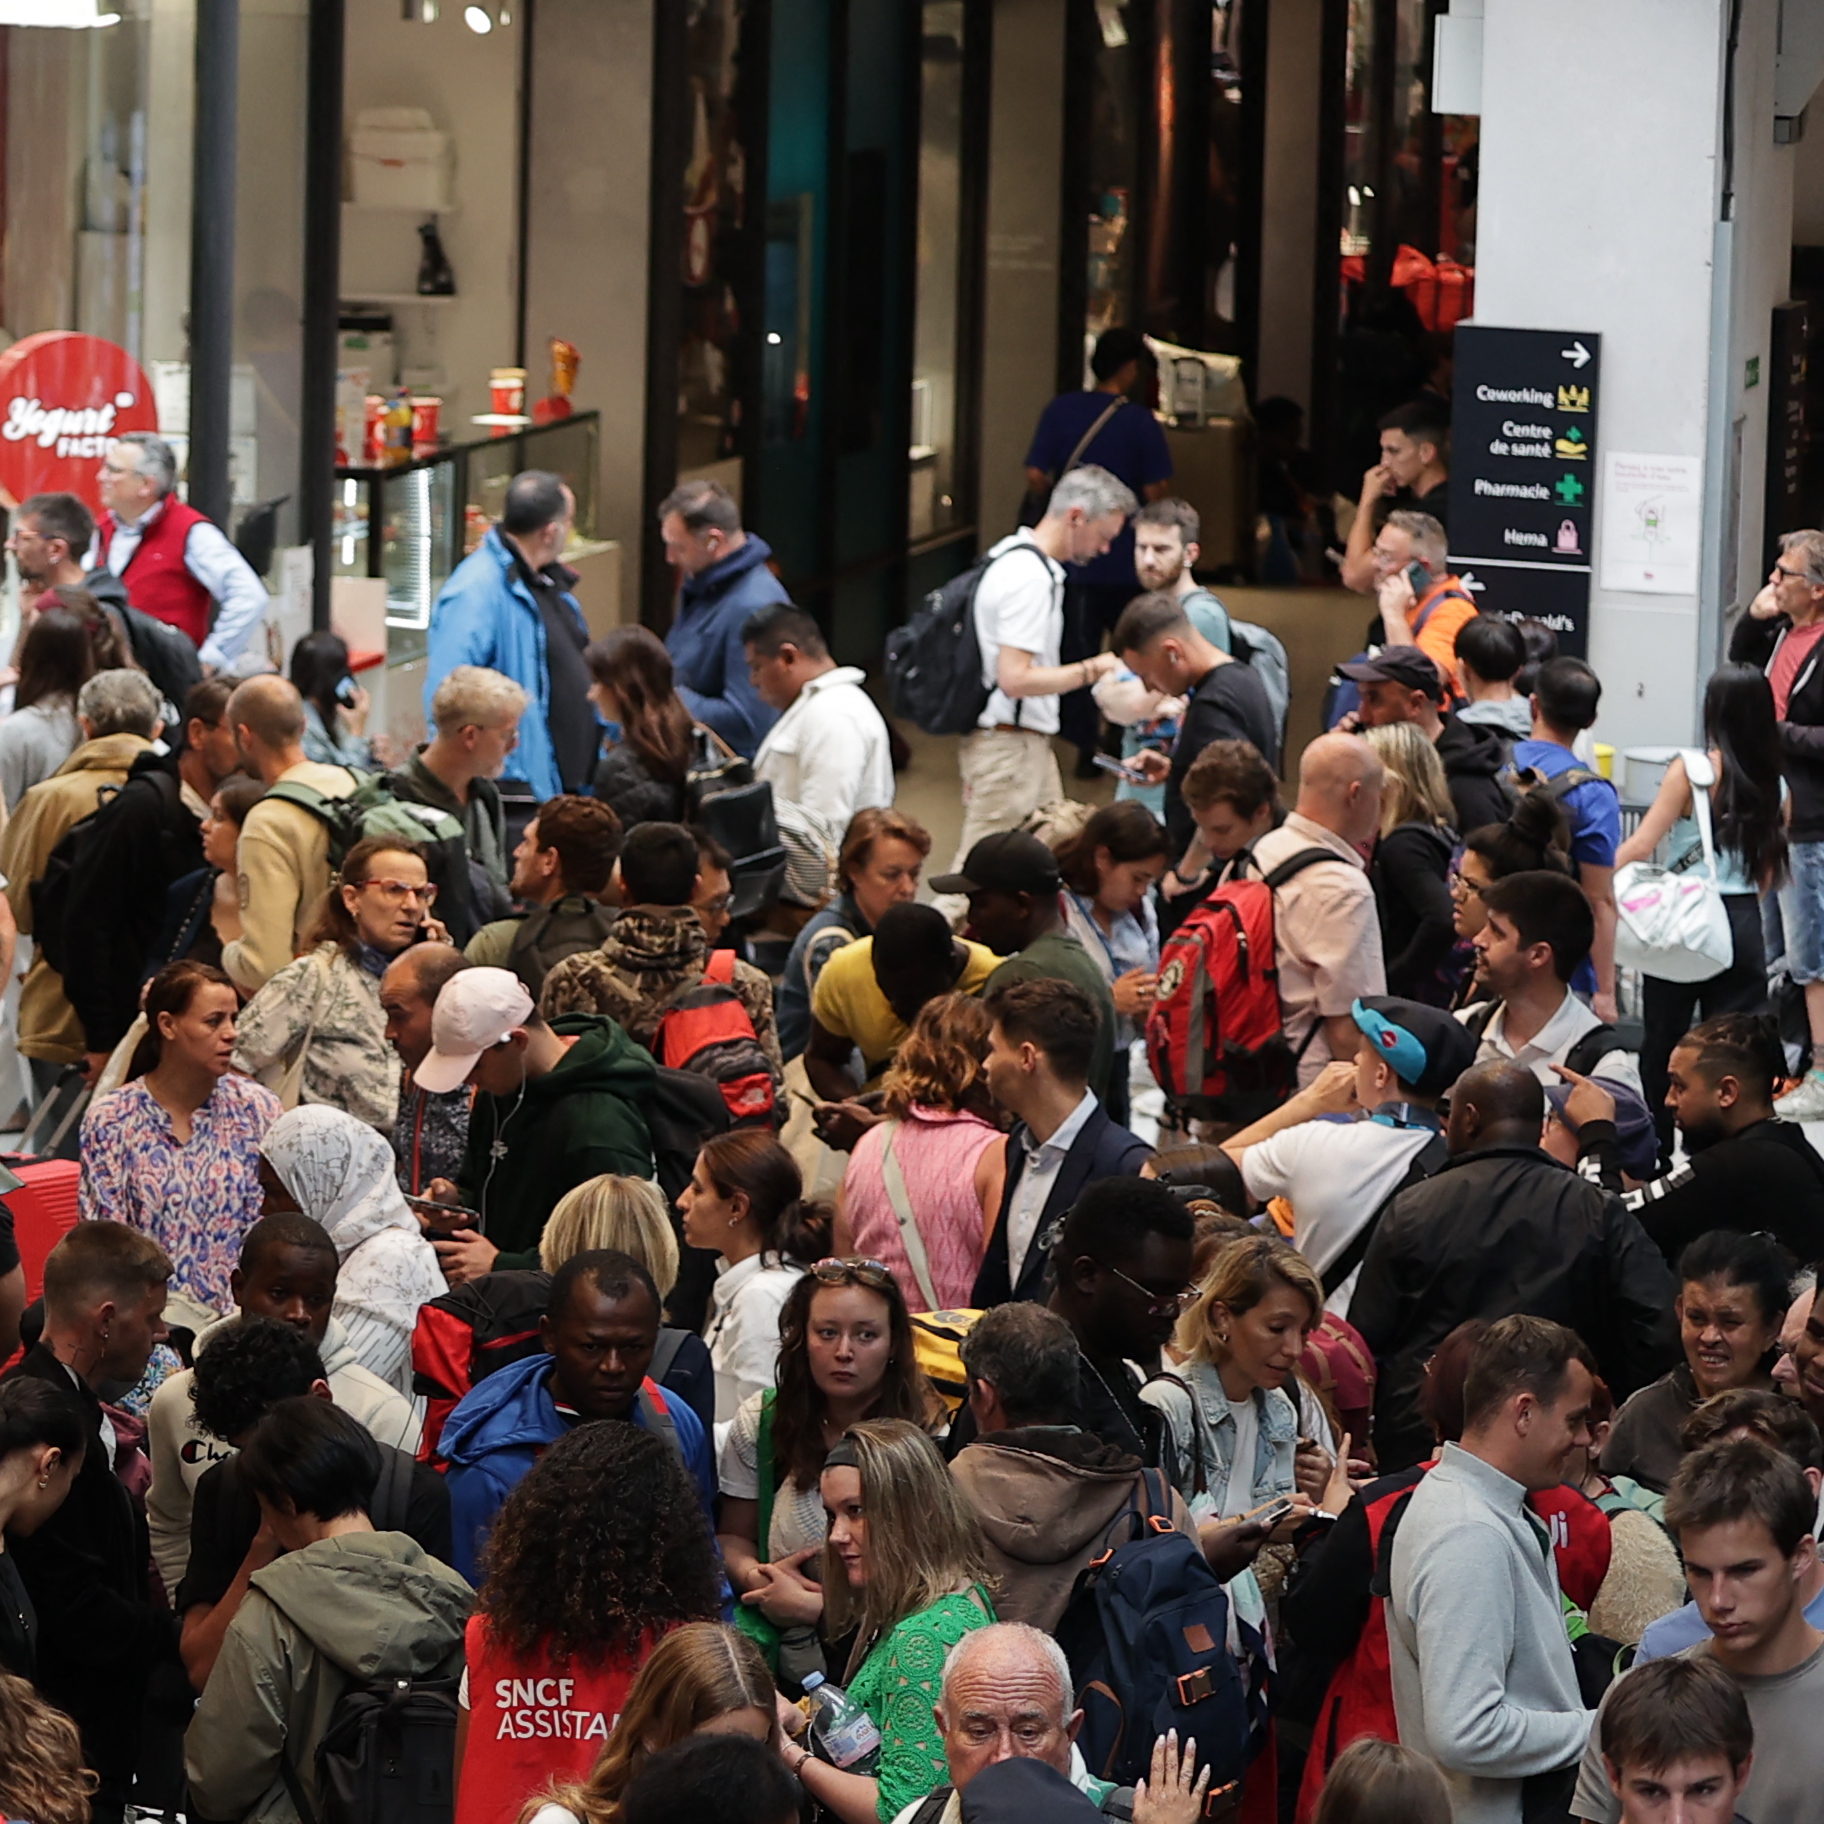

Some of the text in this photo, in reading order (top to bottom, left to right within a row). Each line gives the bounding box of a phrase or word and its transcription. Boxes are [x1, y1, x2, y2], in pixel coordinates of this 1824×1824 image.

[1476, 384, 1555, 409] Coworking
[1, 396, 116, 448] Yogurt
[1502, 420, 1553, 439] Centre
[1489, 439, 1553, 458] de santé
[1474, 478, 1551, 500] Pharmacie
[1504, 527, 1549, 547] Hema
[495, 1678, 575, 1709] SNCF
